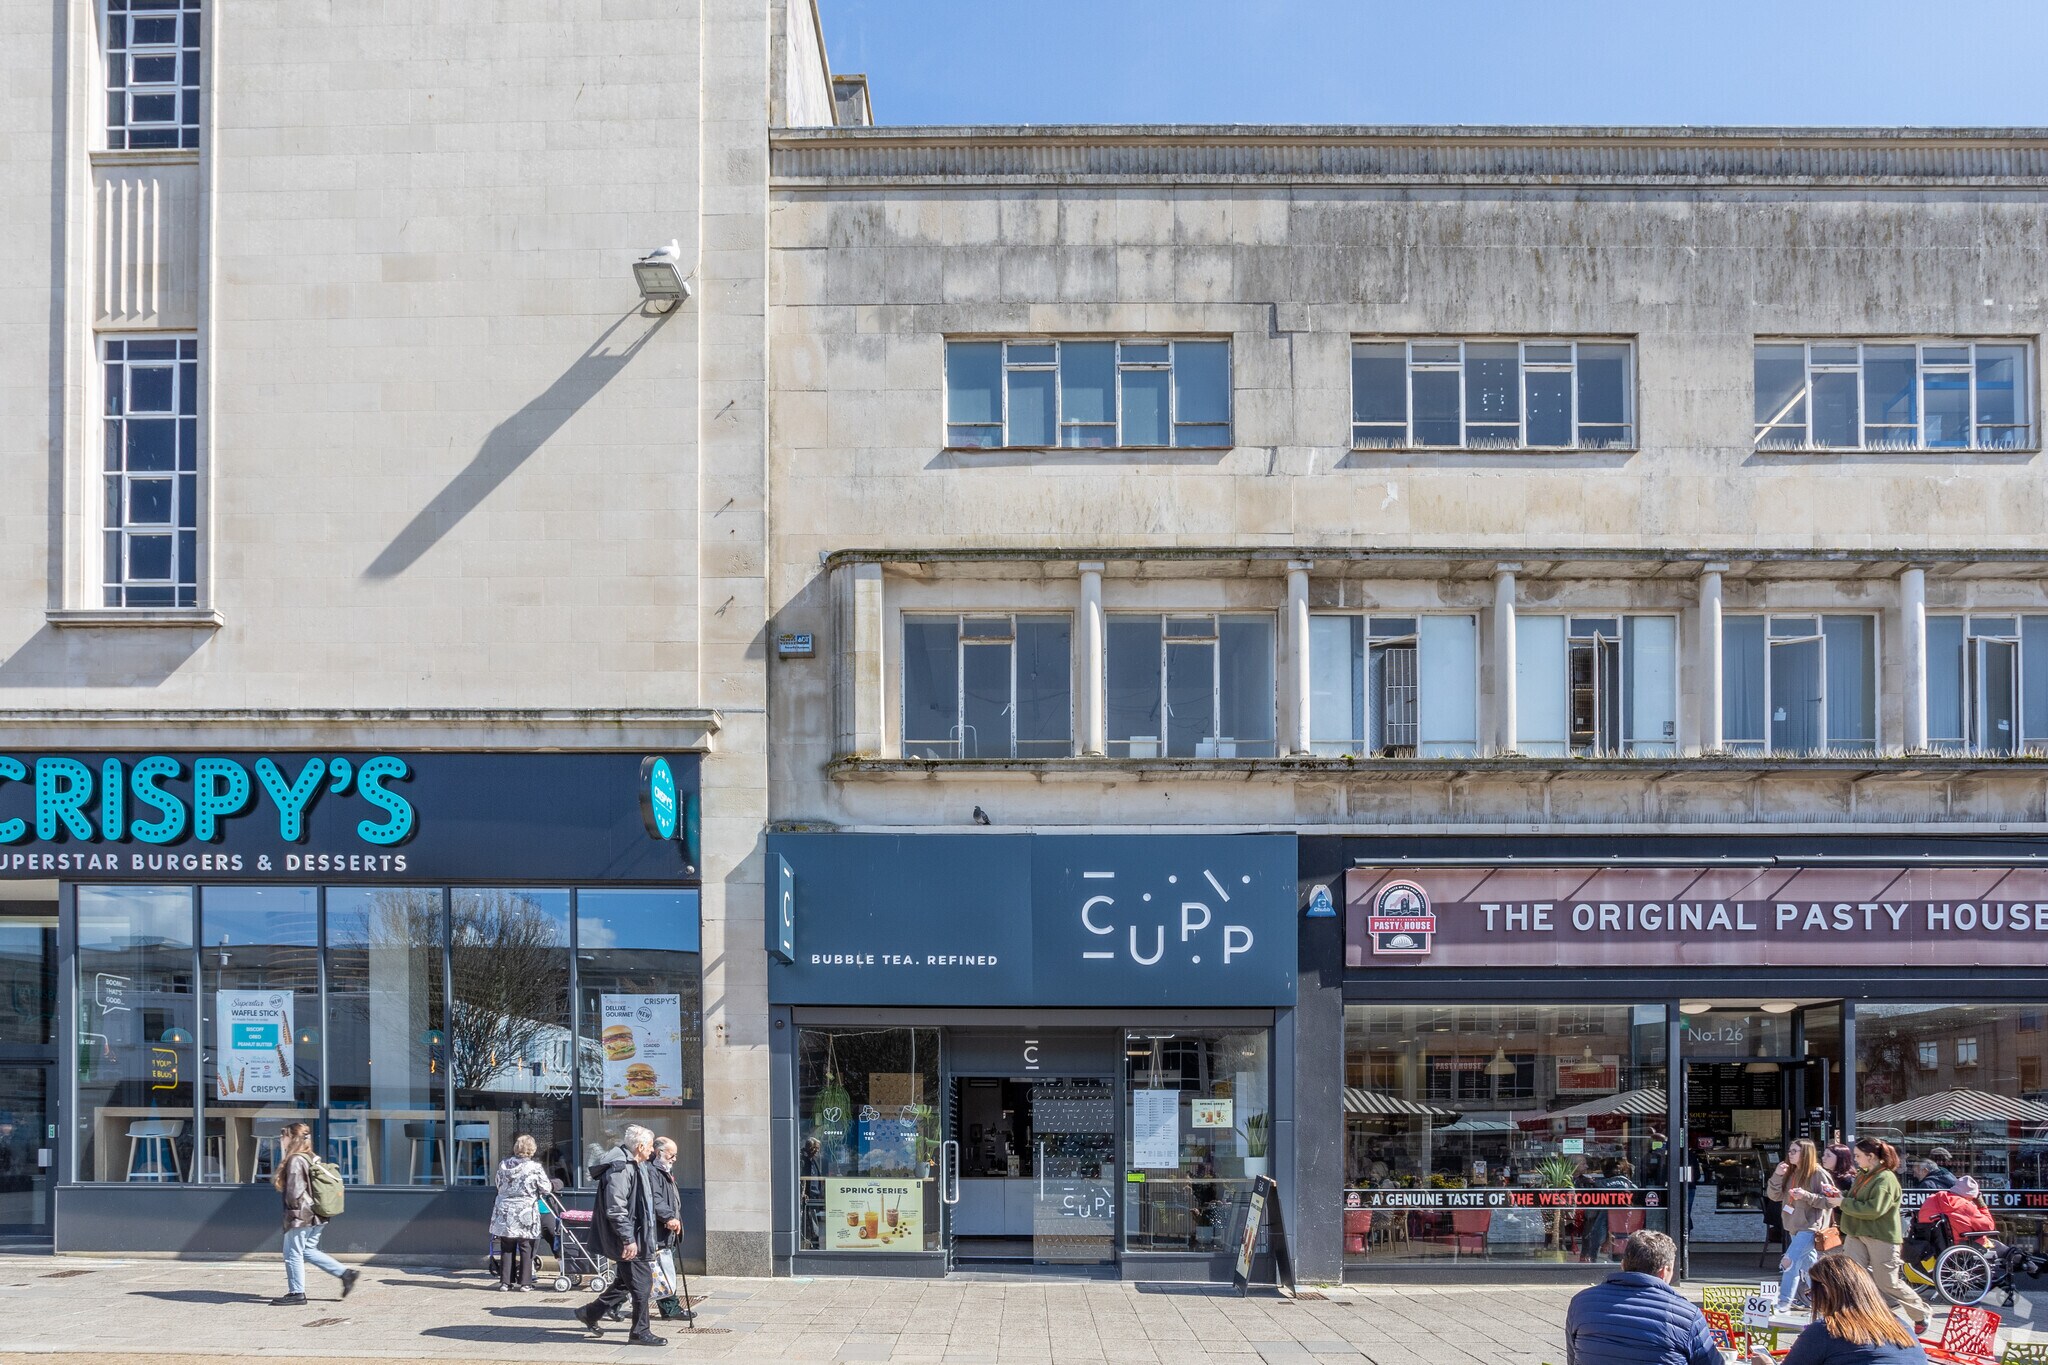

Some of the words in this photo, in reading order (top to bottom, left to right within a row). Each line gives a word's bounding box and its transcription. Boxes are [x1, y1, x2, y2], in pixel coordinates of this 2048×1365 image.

[132, 853, 244, 871] BURGERS
[257, 853, 272, 871] &
[286, 854, 407, 871] DESSERTS
[1480, 904, 1554, 931] THE
[1572, 904, 1757, 931] ORIGINAL
[1776, 904, 1909, 931] PASTY
[1927, 904, 2048, 931] HOUSE
[1082, 895, 1254, 965] CUPP
[1374, 921, 1400, 930] PASTY
[1404, 921, 1431, 930] HOUSE
[811, 954, 875, 965] BUBBLE
[882, 954, 921, 966] TEA.
[928, 955, 998, 966] REFINED
[231, 1009, 258, 1017] WAFFLE
[259, 1009, 279, 1017] STICK
[638, 1010, 651, 1019] NEW
[1024, 1046, 1038, 1063] C
[251, 1085, 287, 1093] CRISPY'S
[876, 1187, 908, 1195] SERIES
[1372, 1193, 1381, 1206] A
[1386, 1193, 1443, 1206] GENUINE
[1446, 1193, 1484, 1206] TASTE
[1488, 1193, 1505, 1206] OF
[1510, 1193, 1534, 1206] THE
[1538, 1193, 1634, 1206] WESTCOUNTRY
[2004, 1193, 2021, 1206] OF
[2025, 1193, 2048, 1206] THE
[1762, 1285, 1777, 1294] 110
[1747, 1297, 1767, 1313] 86
